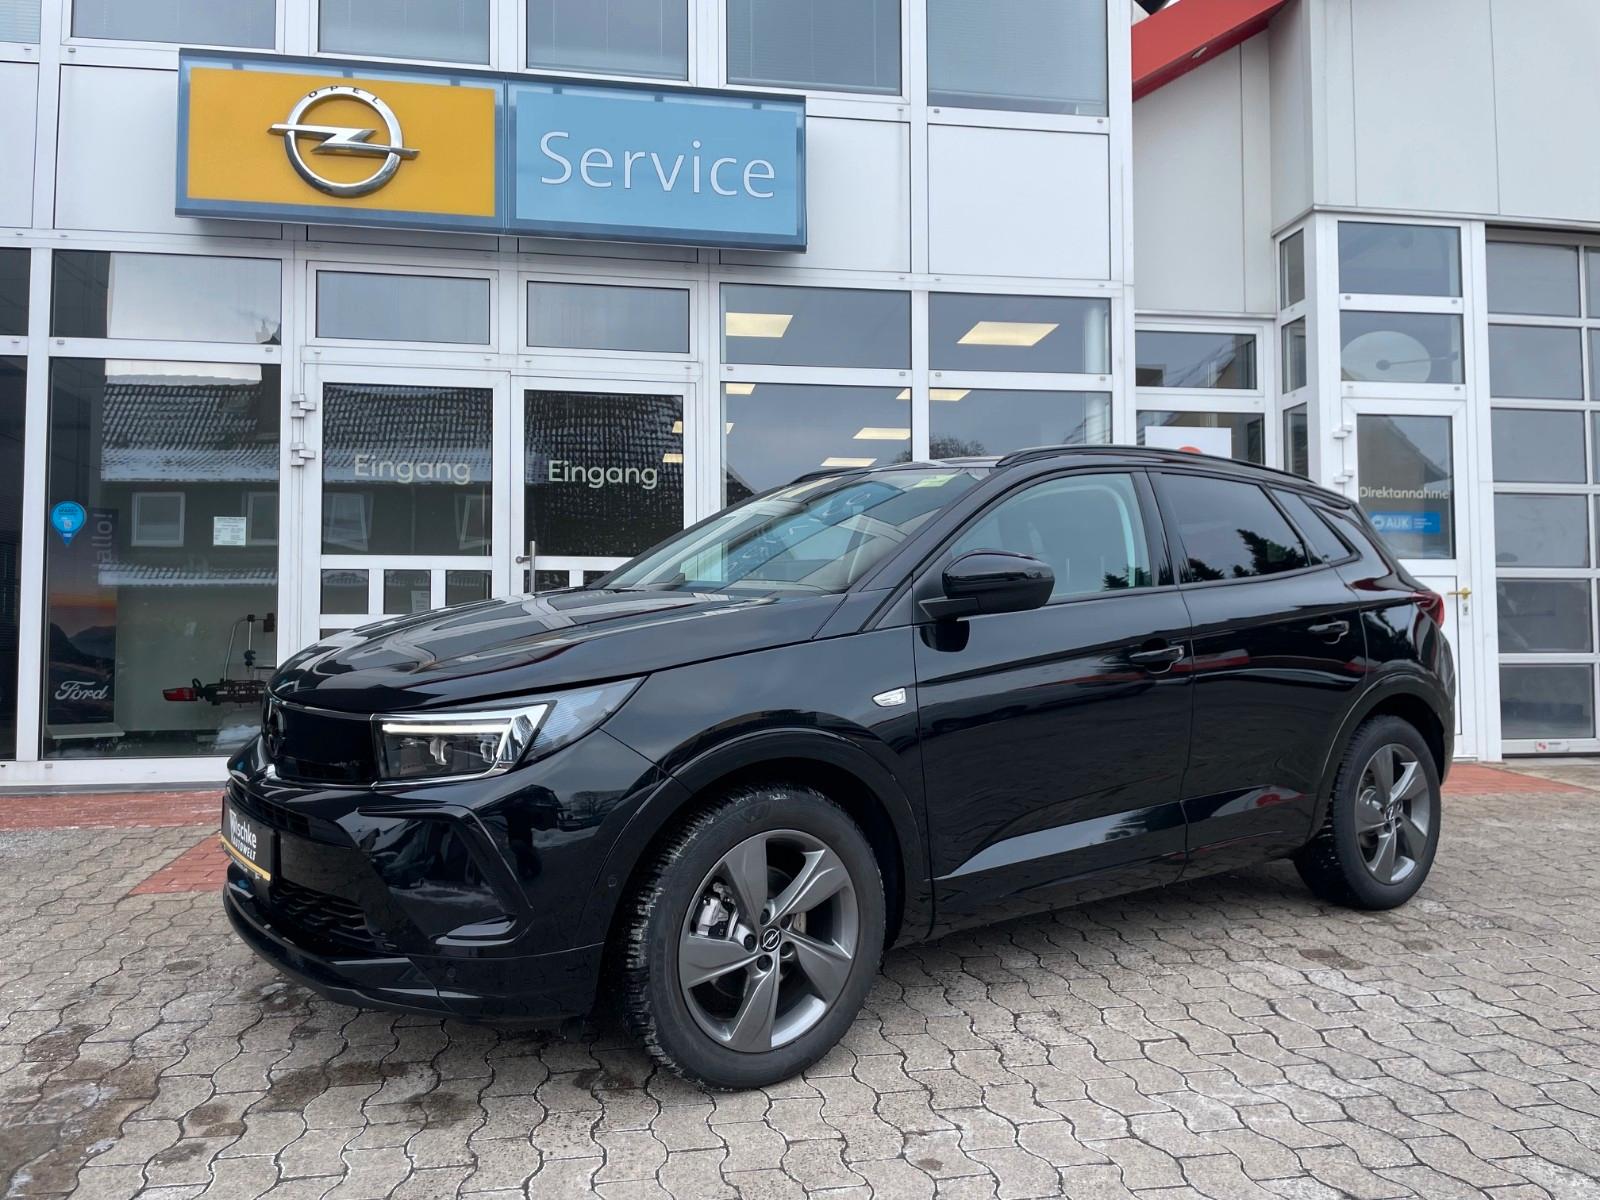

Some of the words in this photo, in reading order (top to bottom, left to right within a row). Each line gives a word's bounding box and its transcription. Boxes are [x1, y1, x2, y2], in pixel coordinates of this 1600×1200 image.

[308, 85, 379, 105] OPEL
[539, 131, 775, 198] Service
[354, 454, 471, 485] Eingang
[548, 459, 658, 490] Eingang
[1359, 486, 1450, 500] Direktannahme
[1385, 516, 1409, 529] AUK
[54, 680, 109, 700] Ford
